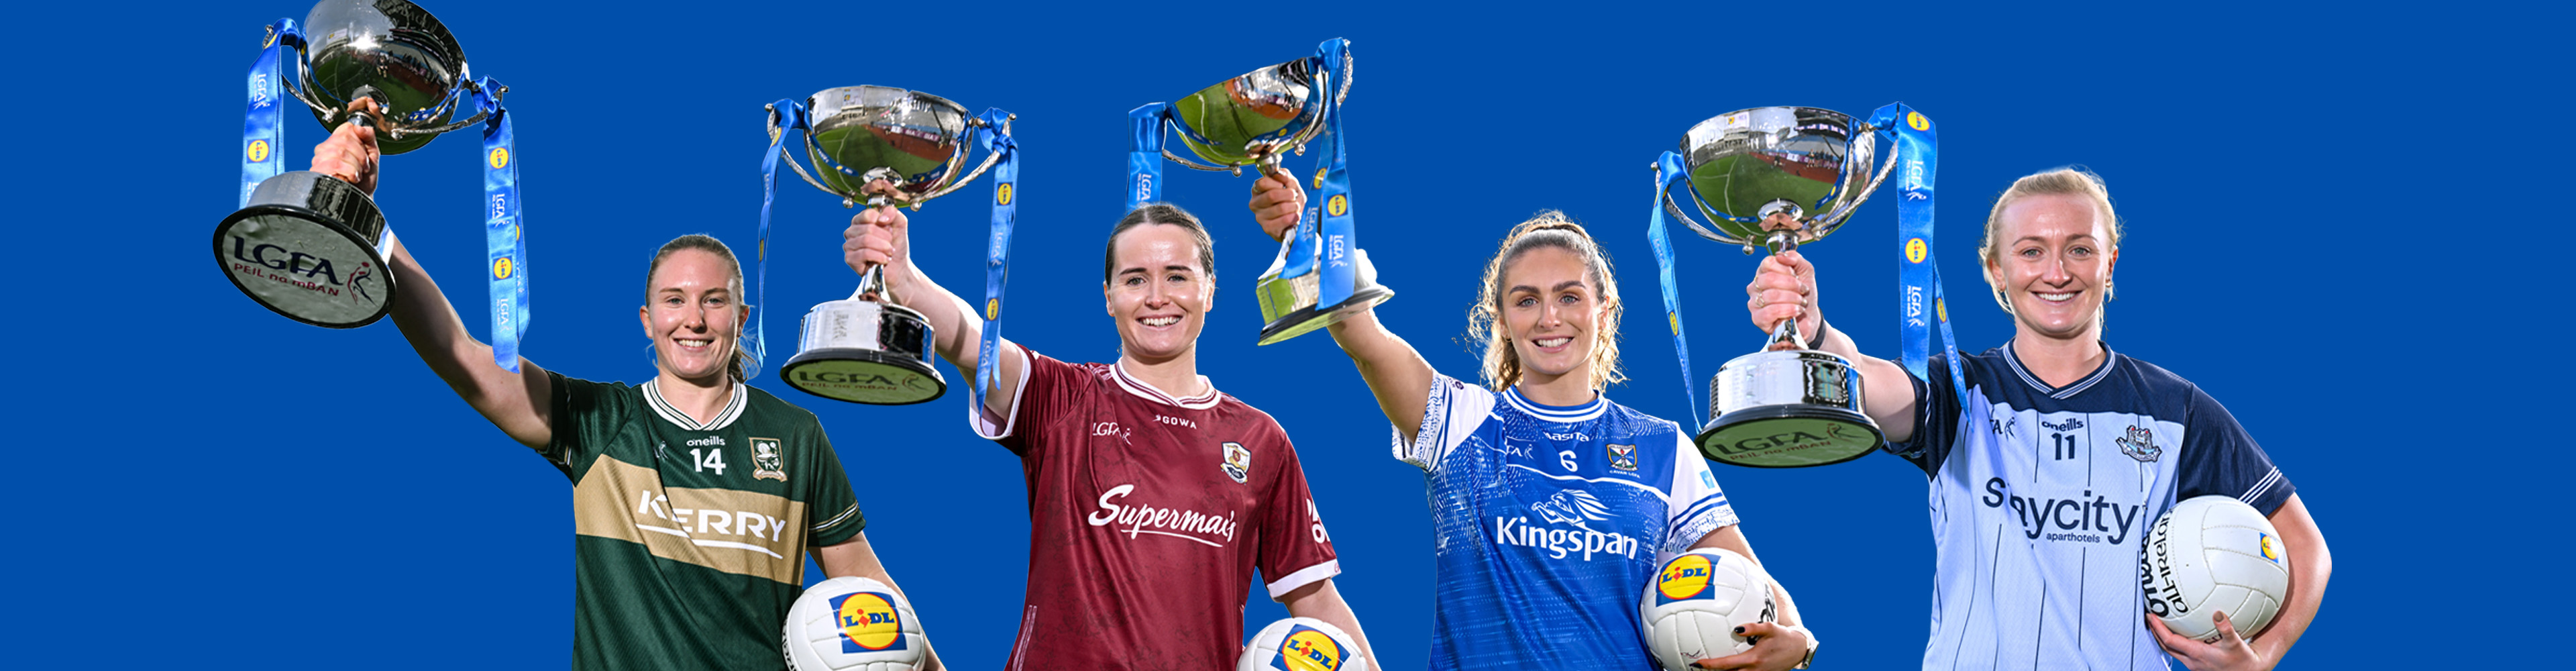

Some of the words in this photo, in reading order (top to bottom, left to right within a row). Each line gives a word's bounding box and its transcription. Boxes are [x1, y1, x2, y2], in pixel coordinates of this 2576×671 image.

[1141, 174, 1151, 201] LGFA
[1910, 161, 1923, 191] LGFA
[496, 193, 505, 219] LGFA
[1332, 234, 1344, 260] LGFA
[233, 236, 344, 286] LGFA
[234, 262, 265, 278] PEIL
[269, 273, 288, 283] na
[292, 280, 340, 297] mBAN
[500, 298, 509, 325] LGFA
[1911, 286, 1922, 318] LGFA
[798, 371, 898, 386] LGFA
[1162, 415, 1197, 429] GOWA
[1713, 431, 1829, 455] LGFA
[2051, 432, 2076, 461] 11
[689, 448, 727, 476] 14
[1558, 450, 1578, 472] 6
[638, 490, 786, 543] KERRY
[1982, 476, 2140, 545] Saycity
[1497, 516, 1638, 562] Kingspan
[2046, 532, 2100, 543] aparthotels
